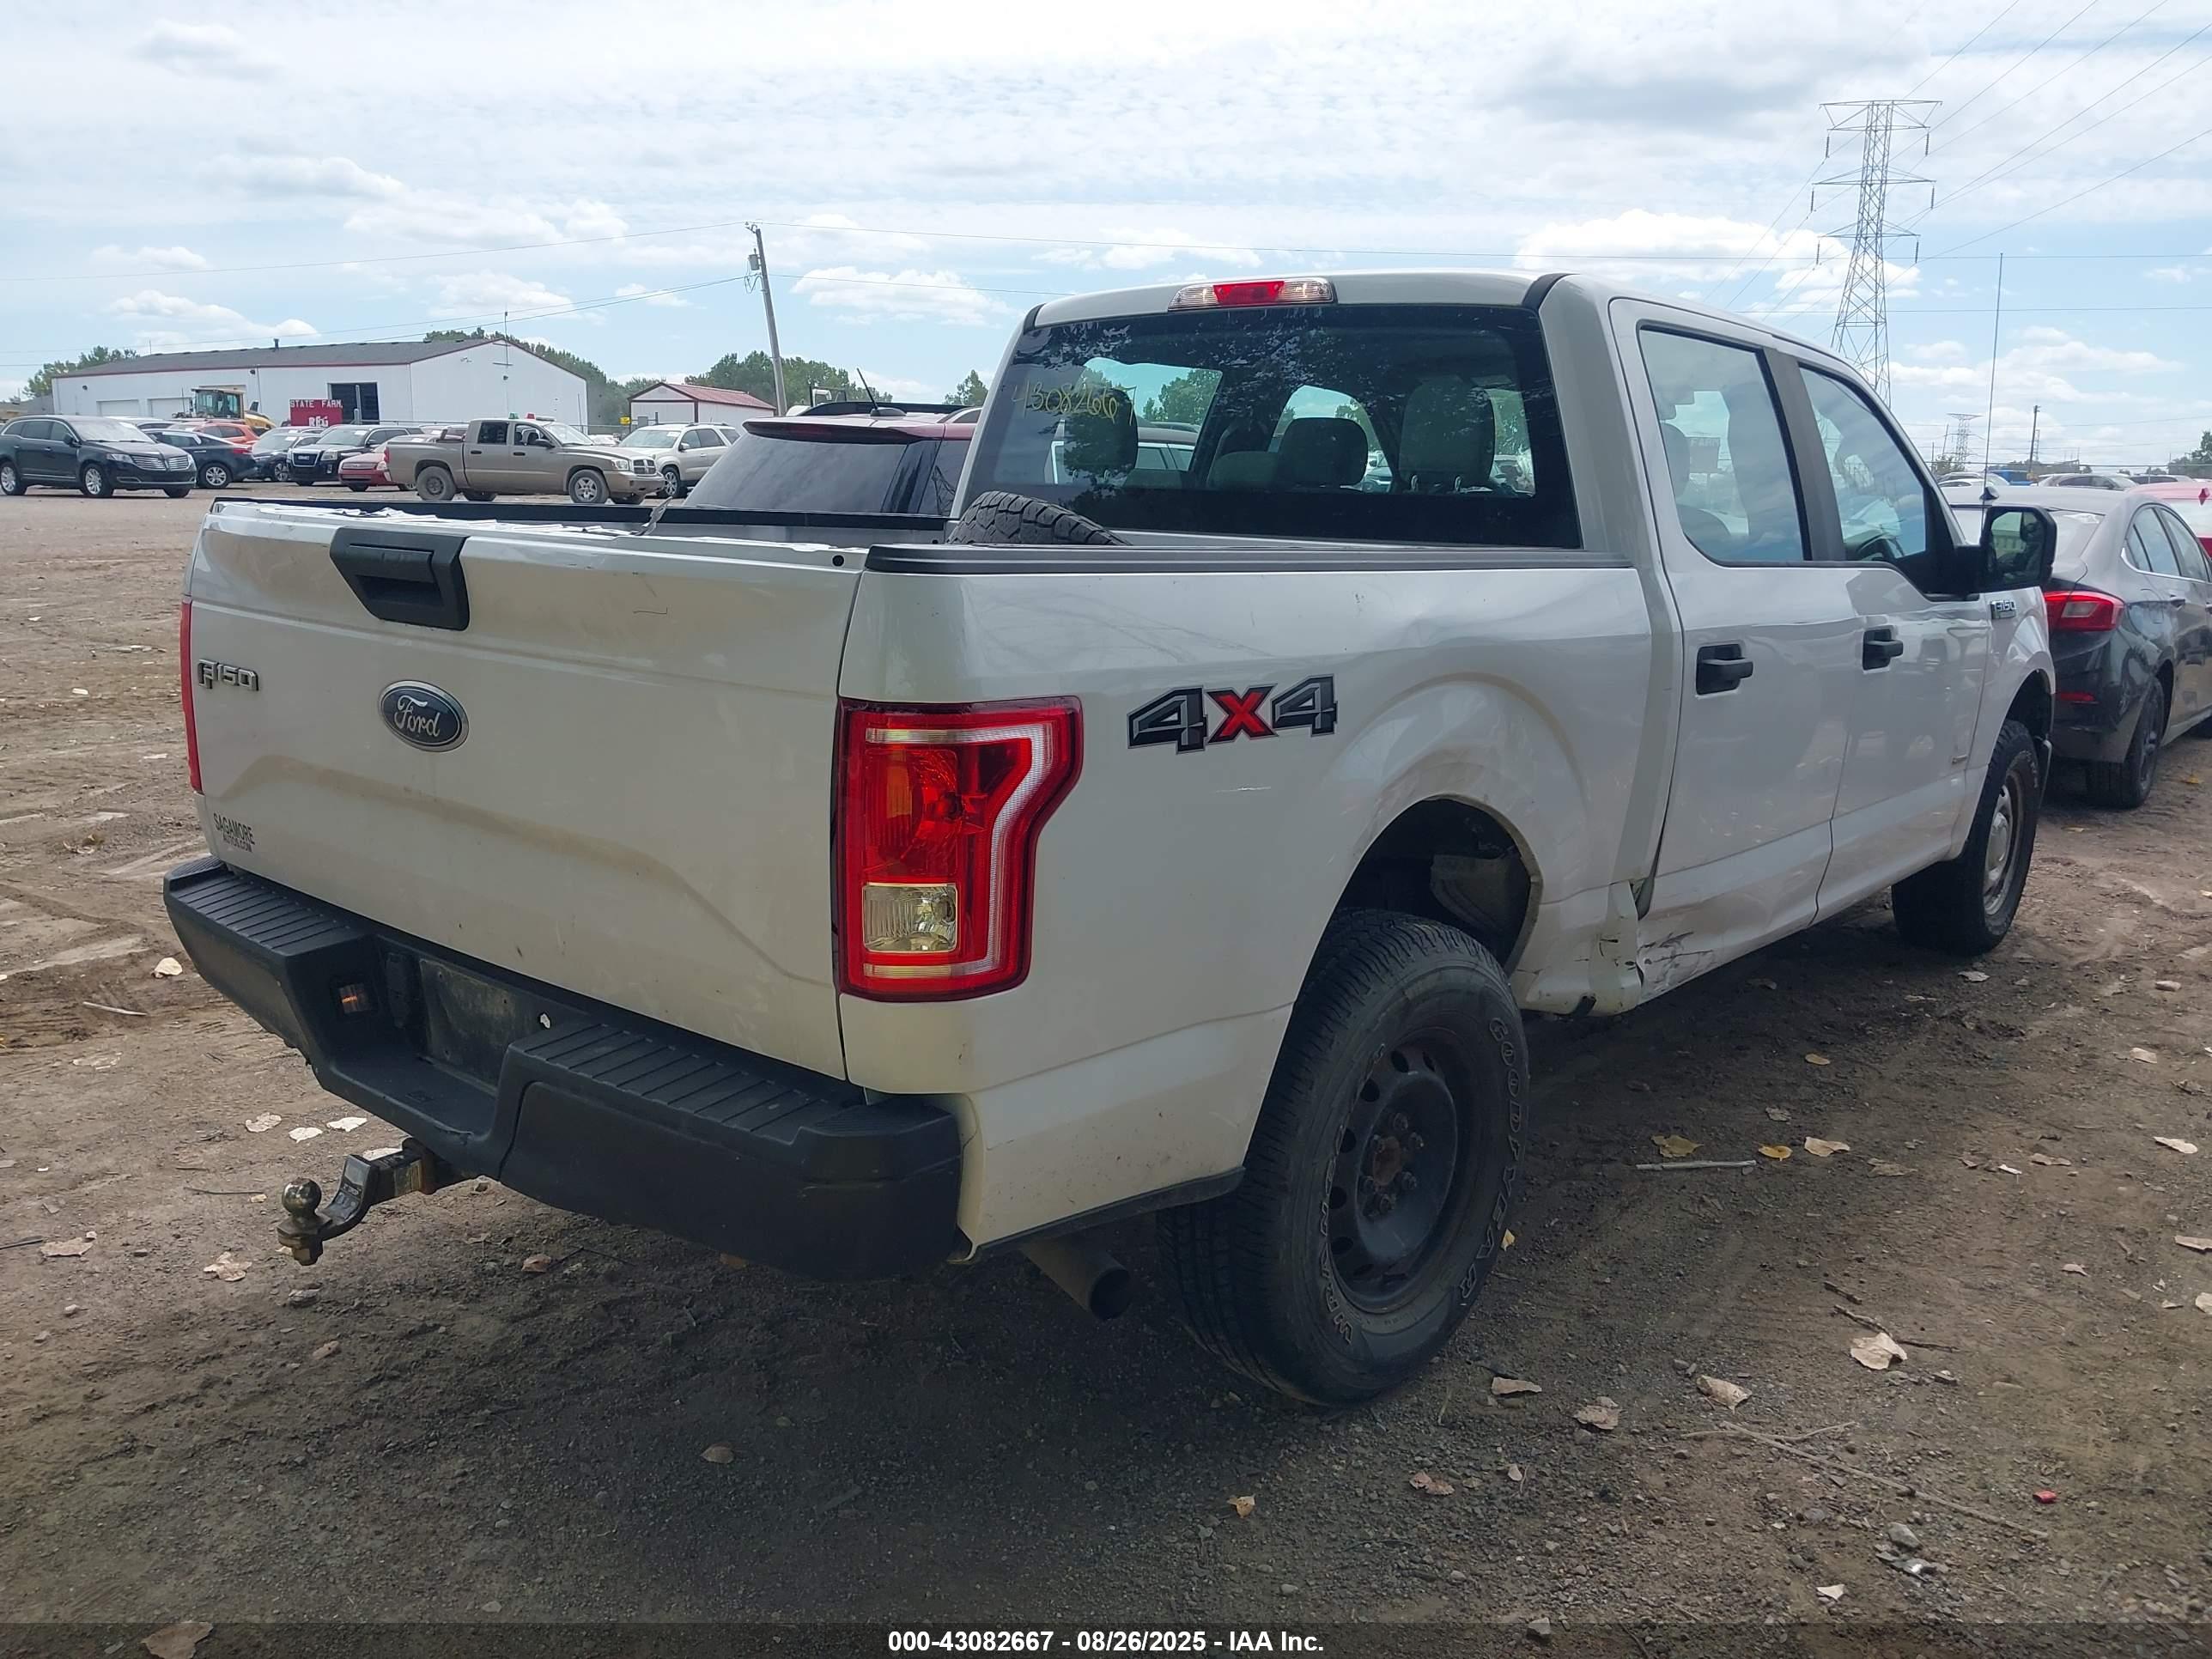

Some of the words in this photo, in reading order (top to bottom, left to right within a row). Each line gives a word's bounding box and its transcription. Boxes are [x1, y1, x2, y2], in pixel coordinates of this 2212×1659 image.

[290, 399, 314, 408] STATE
[198, 659, 259, 691] F150
[394, 695, 441, 738] Ford
[213, 812, 256, 846] SAGAMORE
